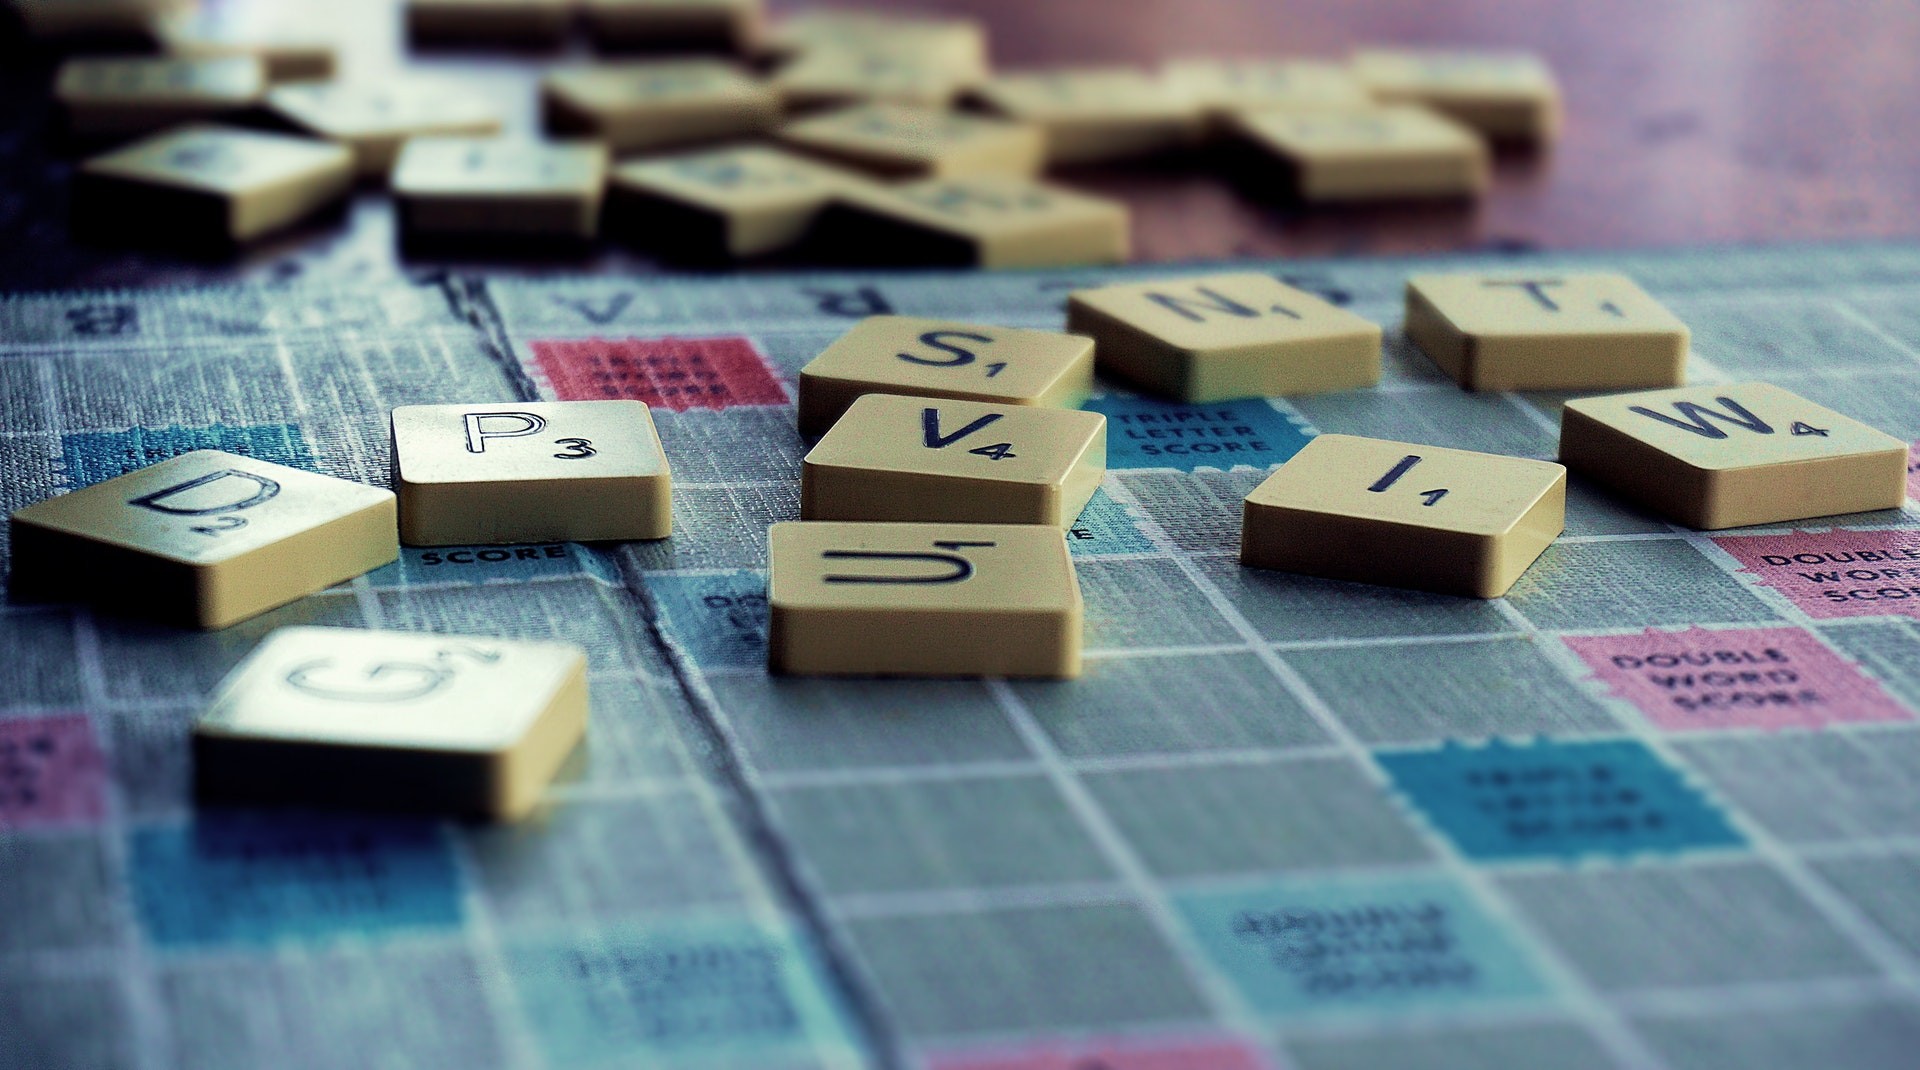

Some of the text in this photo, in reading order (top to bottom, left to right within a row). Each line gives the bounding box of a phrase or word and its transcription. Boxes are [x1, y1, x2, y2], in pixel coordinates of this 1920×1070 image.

[1143, 284, 1261, 323] N
[1479, 279, 1564, 312] T
[897, 331, 993, 367] S
[922, 408, 1017, 460] V 4
[1114, 411, 1239, 424] TRIPLE
[1125, 426, 1257, 439] LETTER
[1627, 397, 1830, 440] W 4
[463, 412, 597, 459] P 3
[1141, 441, 1273, 455] SCORE
[1367, 455, 1422, 492] I
[127, 469, 281, 516] D
[421, 545, 567, 565] SCORE
[822, 550, 974, 584] U
[1611, 648, 1788, 669] DOUBLE
[284, 655, 456, 702] G
[1650, 669, 1798, 690] WORD
